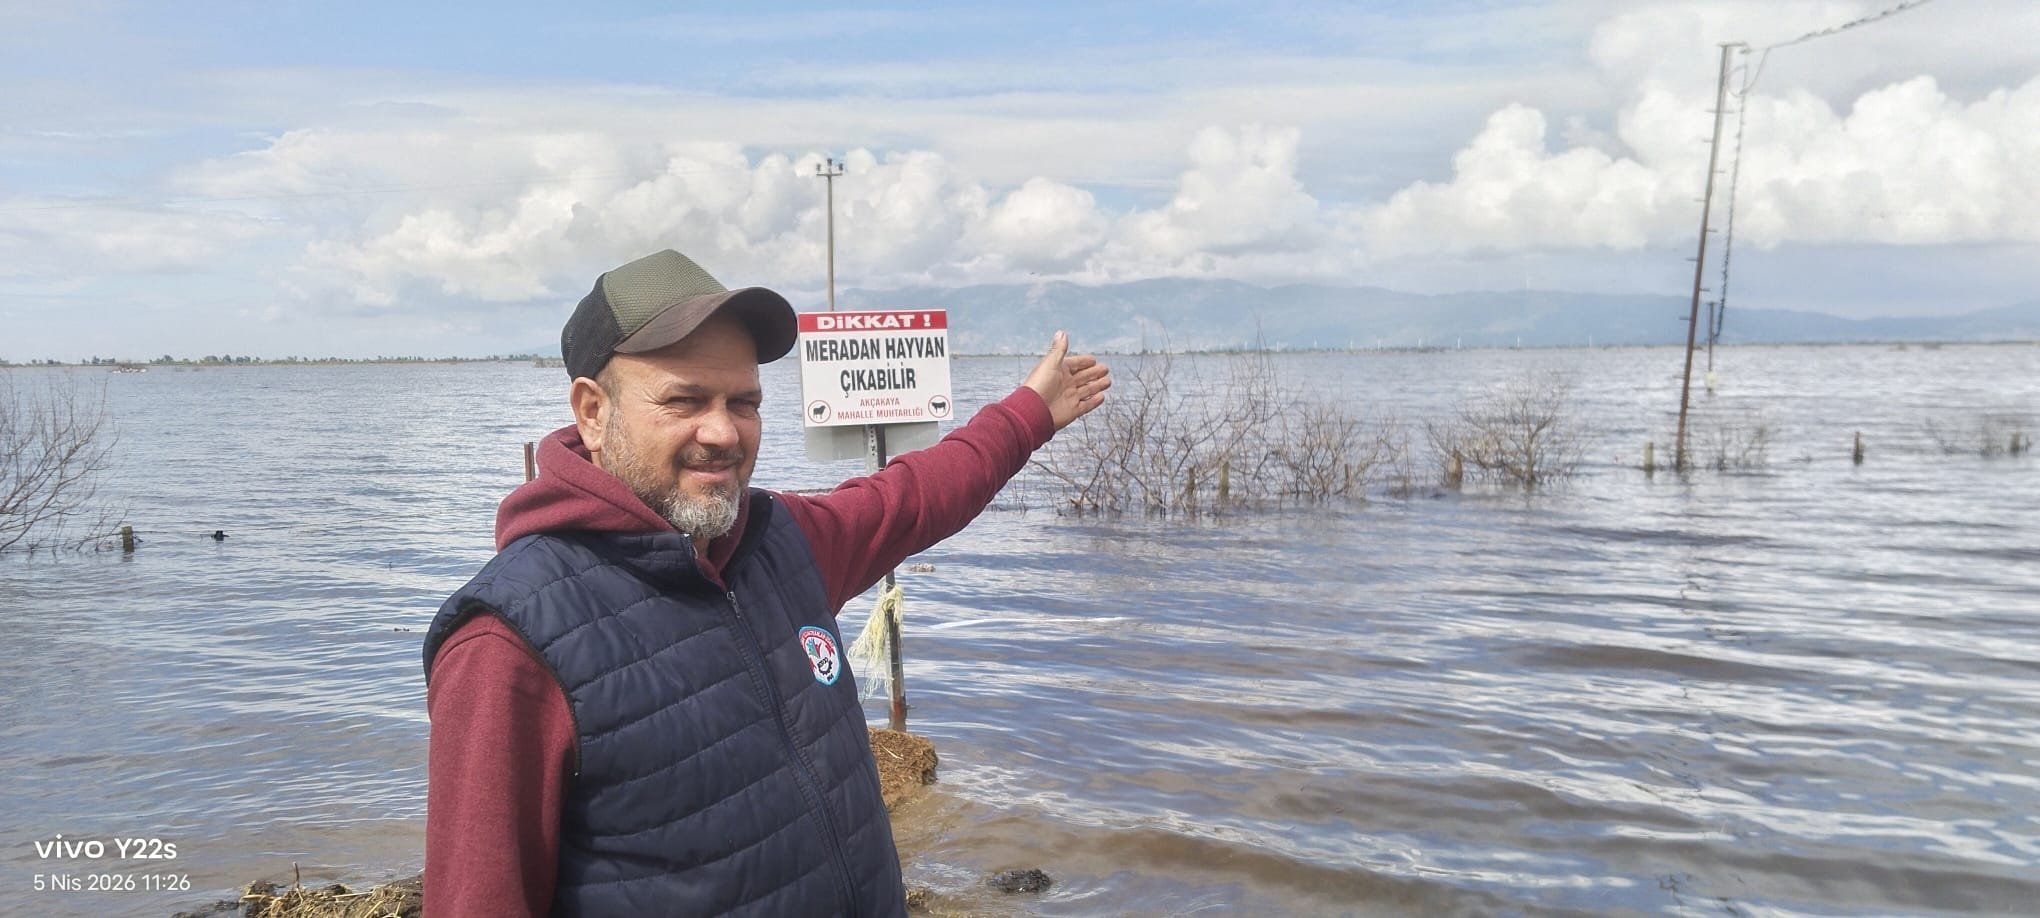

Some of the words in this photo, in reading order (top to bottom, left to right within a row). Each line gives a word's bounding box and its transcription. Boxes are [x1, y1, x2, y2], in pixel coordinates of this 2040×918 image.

[923, 314, 931, 327] !
[805, 338, 880, 362] MERADAN
[885, 336, 945, 359] HAYVAN
[840, 362, 916, 398] ÇIKABİLİR
[859, 398, 900, 408] AKÇAKAYA
[837, 410, 874, 420] MAHALLE
[876, 407, 923, 419] MUHTARLIĞI
